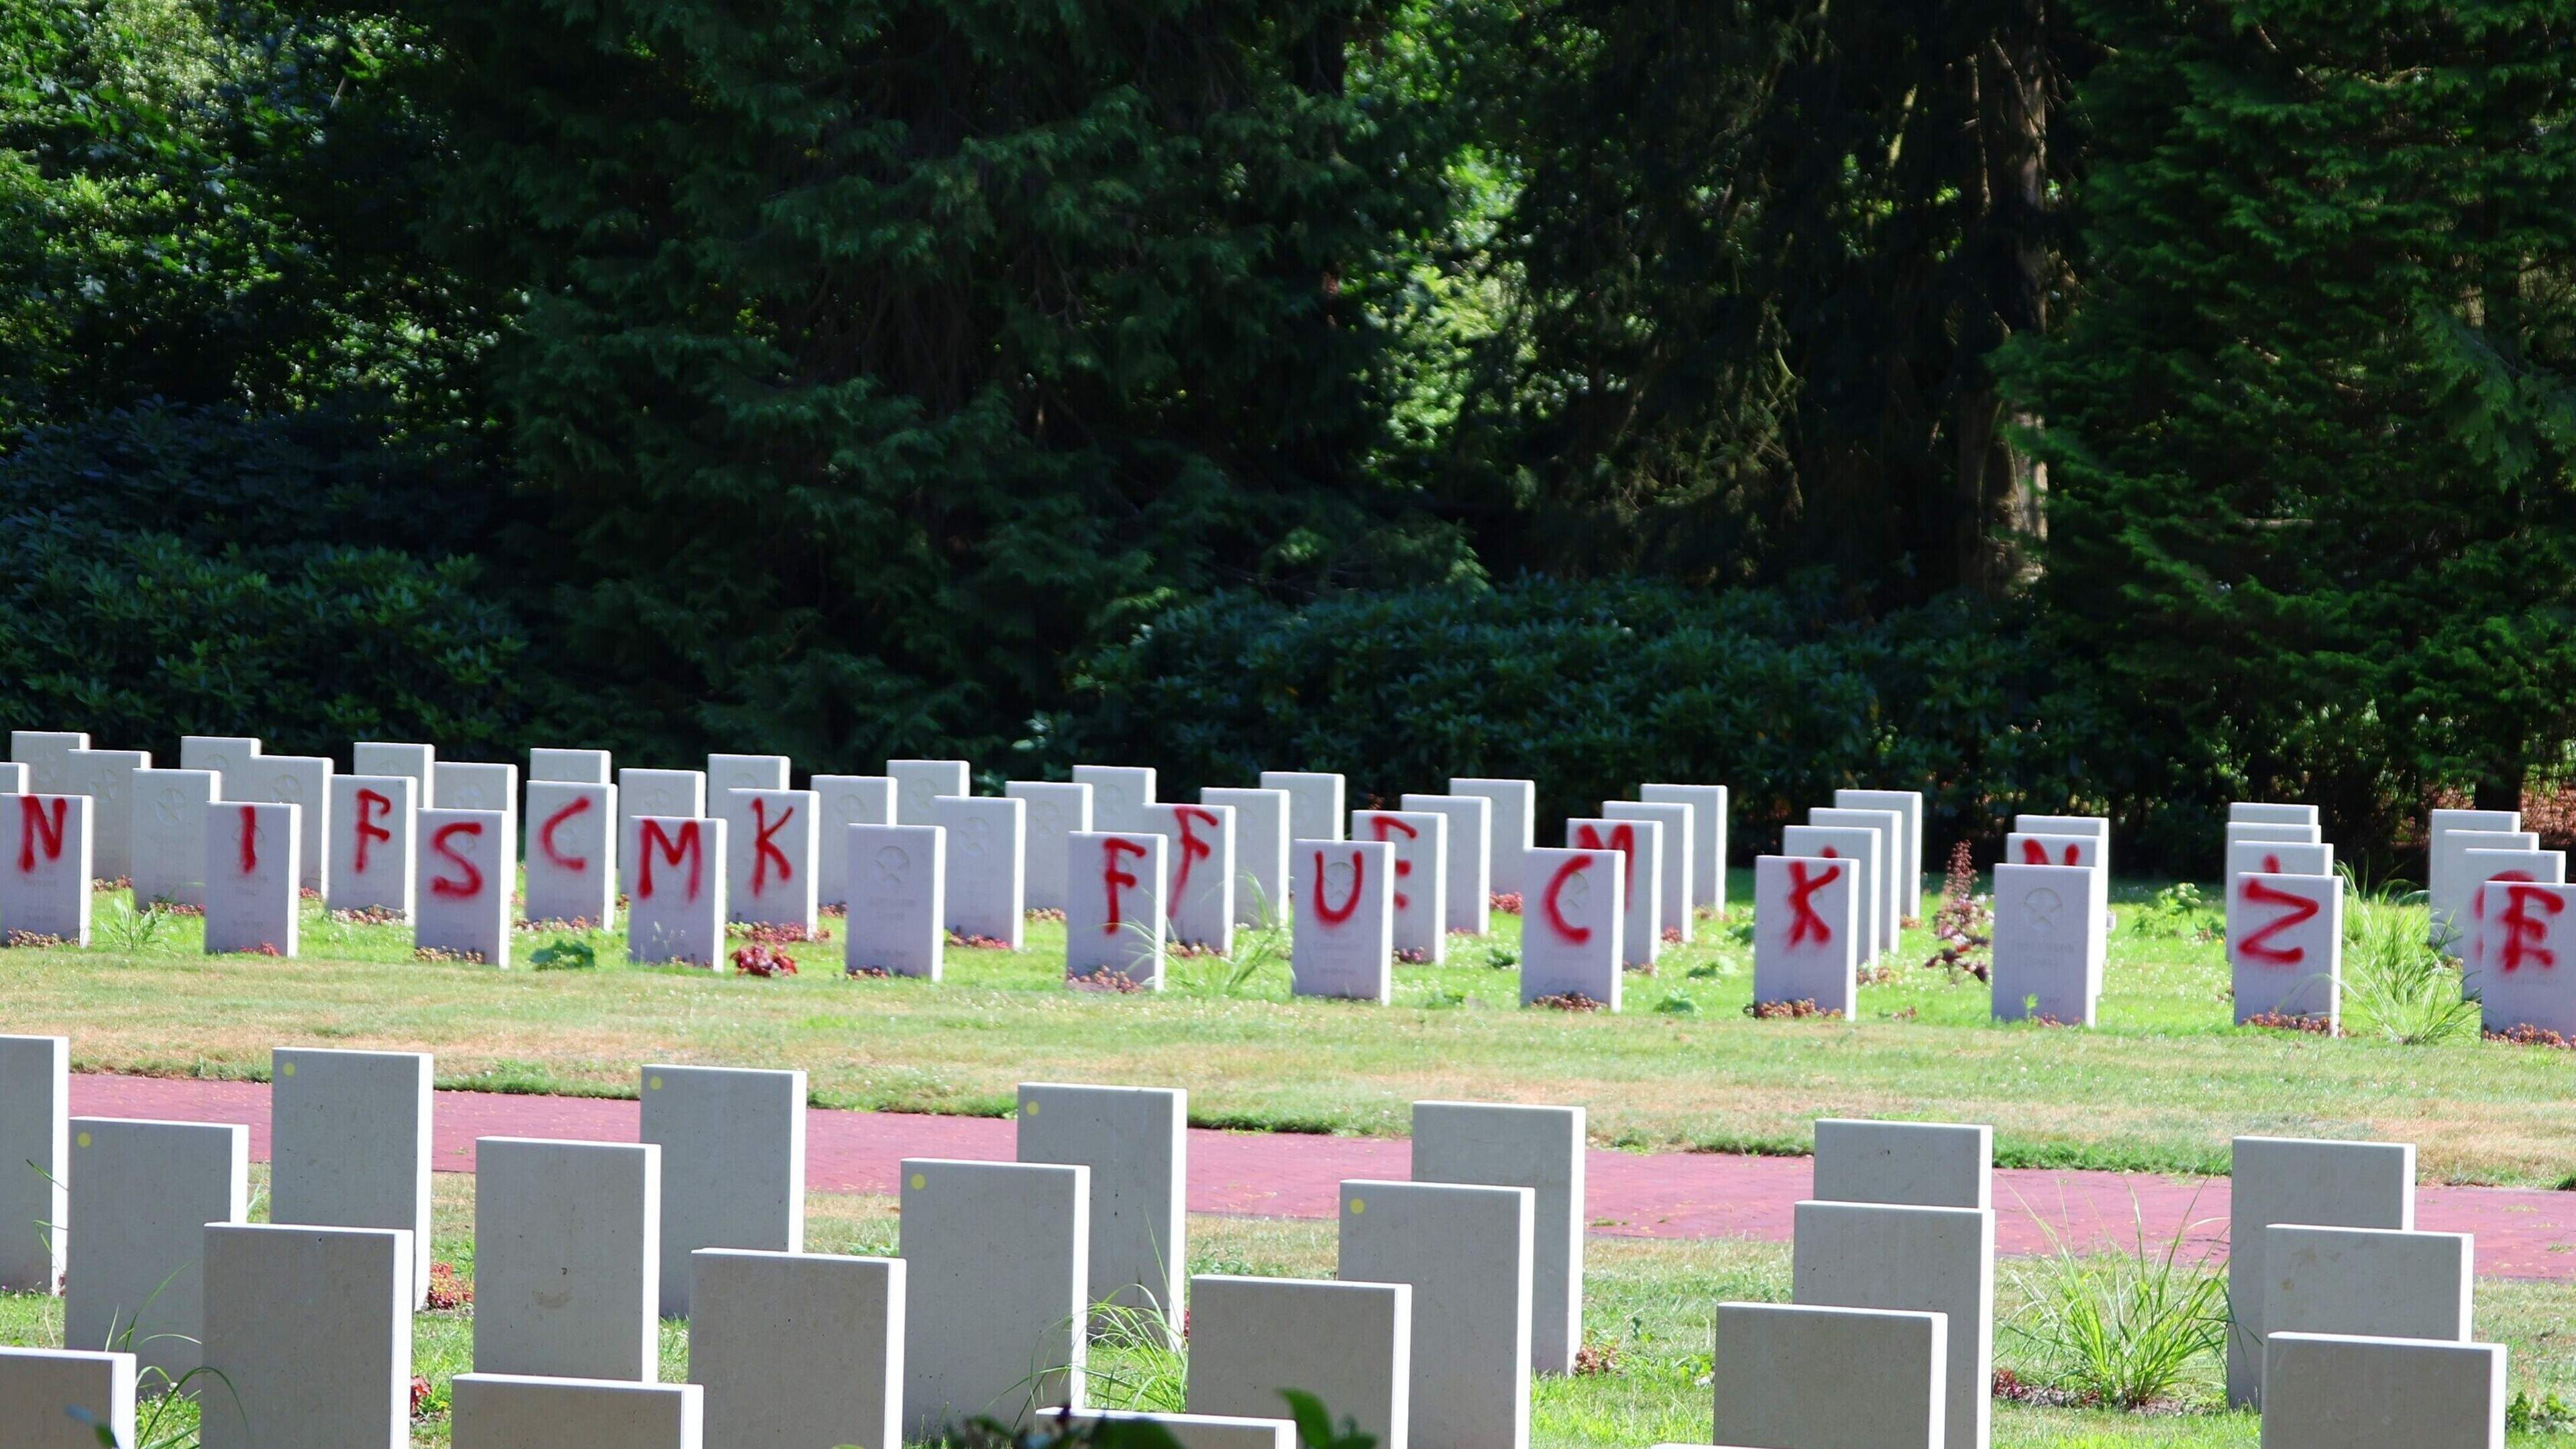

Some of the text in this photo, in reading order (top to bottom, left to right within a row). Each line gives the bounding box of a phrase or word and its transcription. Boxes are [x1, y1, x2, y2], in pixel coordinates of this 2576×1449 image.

[19, 794, 67, 873] N
[239, 806, 258, 875] I
[356, 789, 391, 873] F
[432, 822, 483, 899] S
[541, 798, 590, 871] C
[639, 819, 701, 899] M
[752, 799, 792, 896] K
[1171, 806, 1218, 918] F
[1104, 838, 1146, 934] F
[1314, 852, 1363, 927] U
[1543, 855, 1593, 945] C
[1788, 861, 1840, 947] K
[2239, 879, 2319, 965] Z
